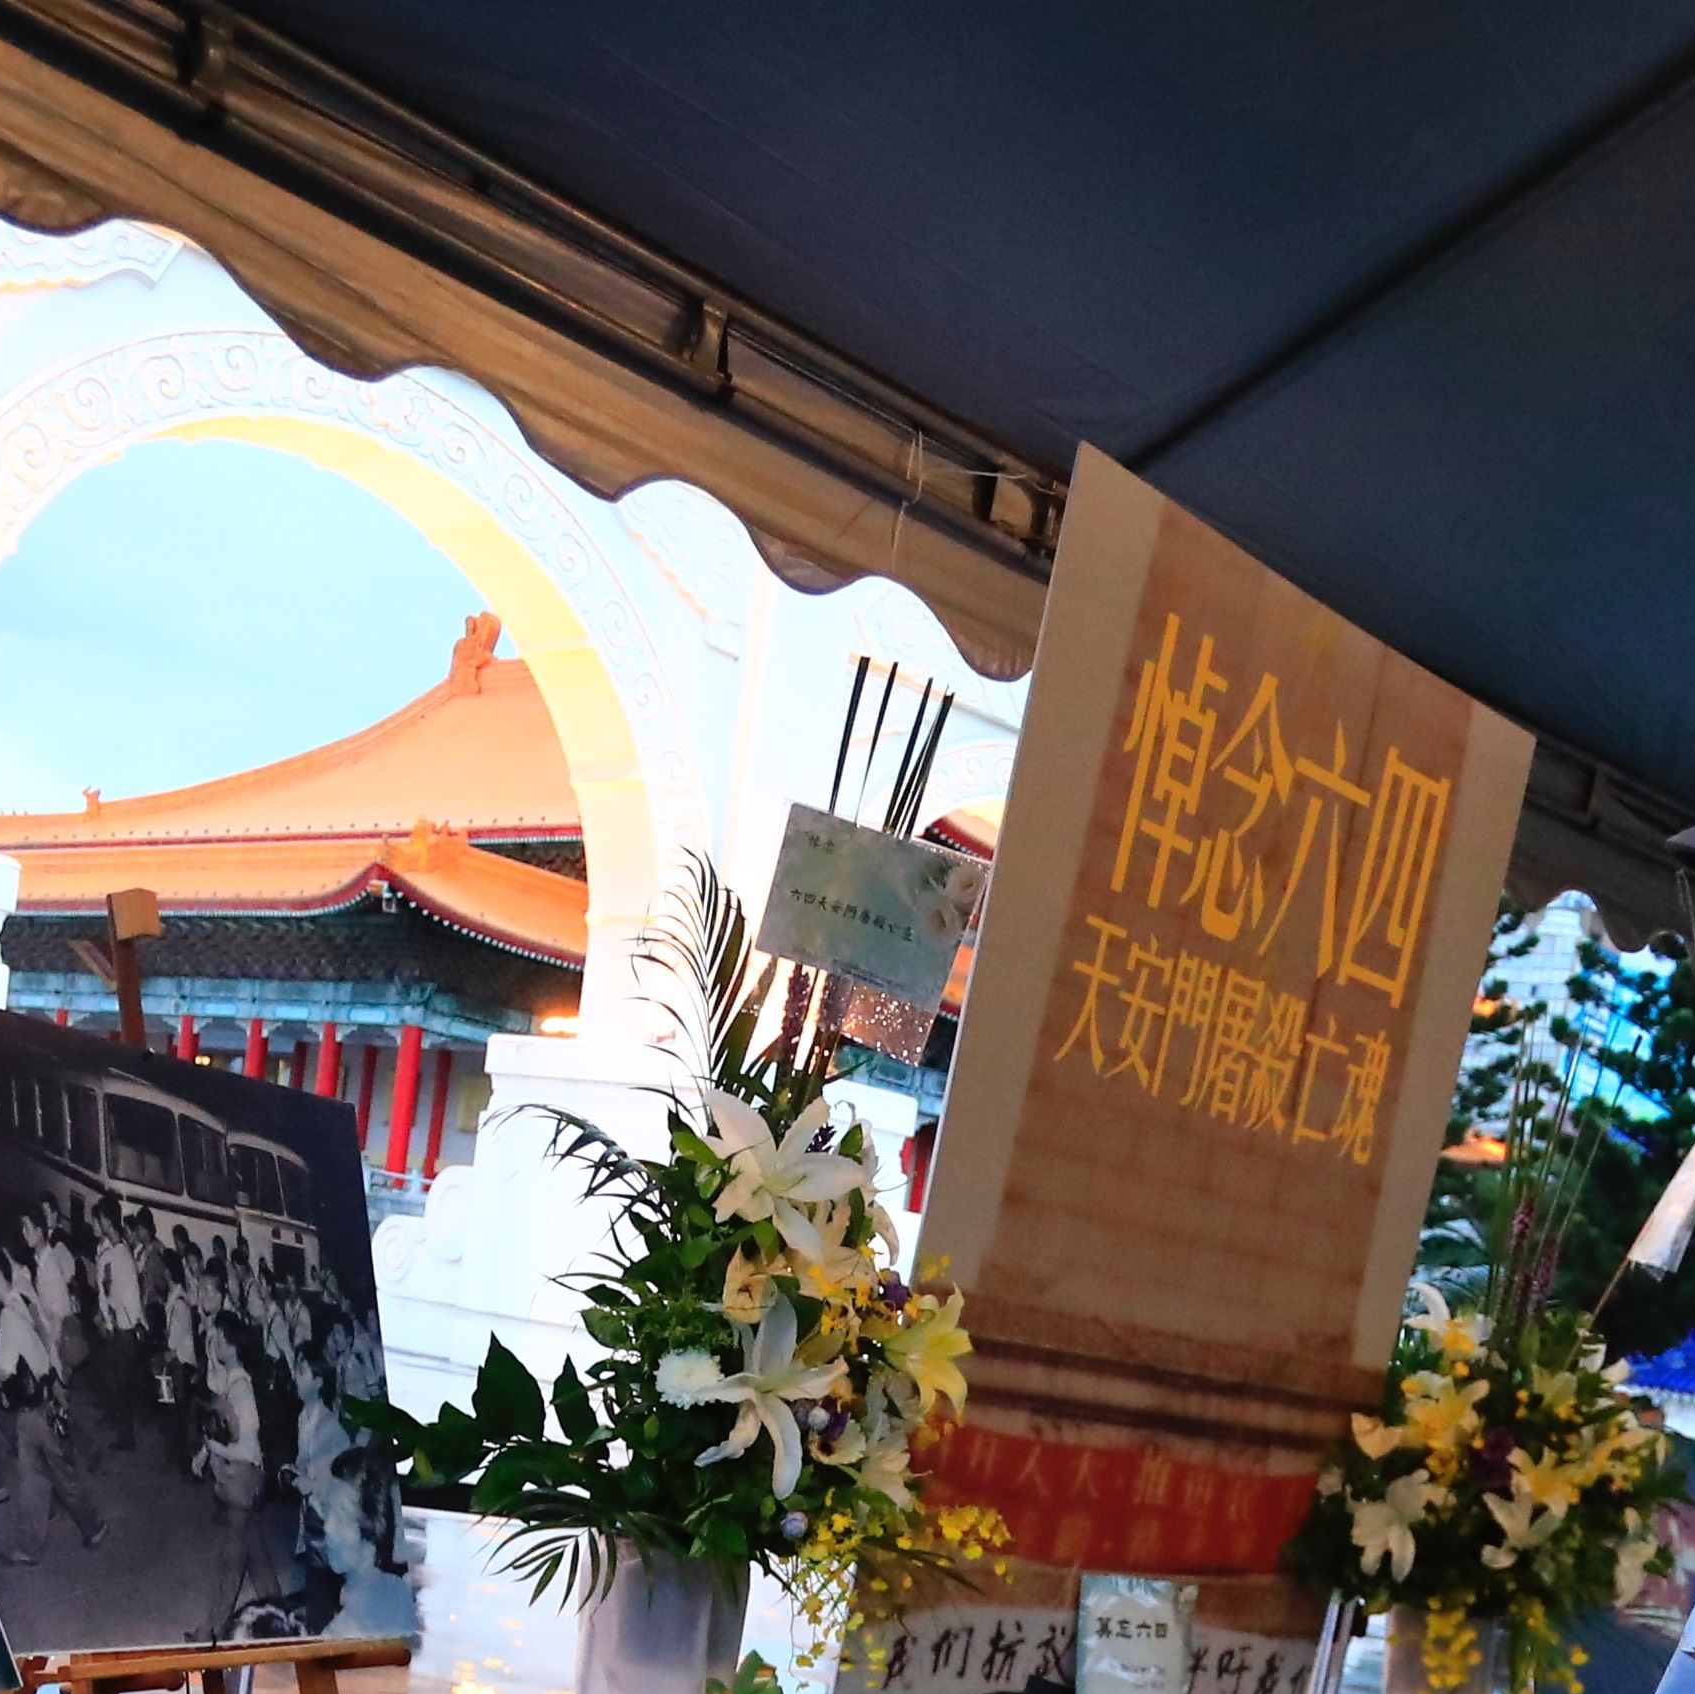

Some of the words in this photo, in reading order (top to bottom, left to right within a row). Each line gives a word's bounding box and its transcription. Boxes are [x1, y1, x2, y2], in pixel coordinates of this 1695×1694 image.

[1109, 611, 1452, 1010] 悼念六四
[1052, 912, 1393, 1166] 天安門屠殺亡魂
